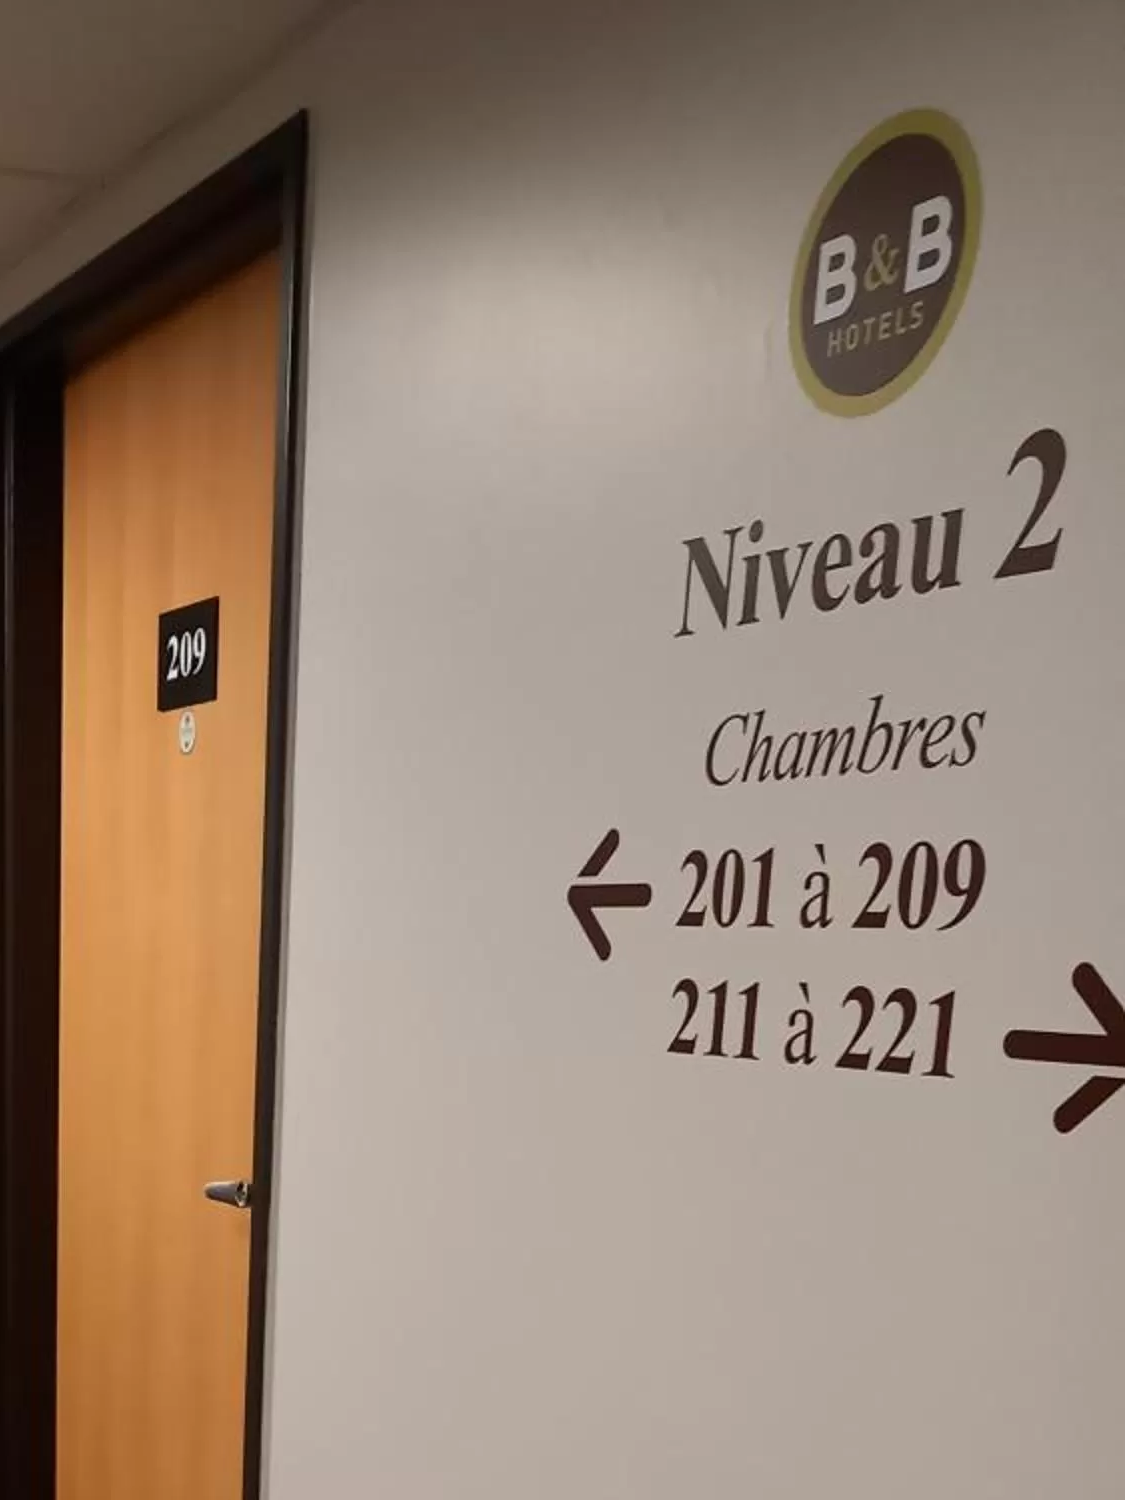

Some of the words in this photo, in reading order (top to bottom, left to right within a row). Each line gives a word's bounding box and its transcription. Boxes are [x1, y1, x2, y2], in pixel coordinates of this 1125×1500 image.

[813, 196, 953, 324] B&B
[827, 301, 925, 357] HOTELS
[675, 508, 964, 638] Niveau
[993, 427, 1067, 579] 2
[166, 627, 207, 681] 209
[705, 694, 987, 786] Chambres
[675, 847, 776, 929] 201
[800, 843, 833, 929] à
[851, 838, 987, 932] 209
[667, 978, 761, 1061] 211
[784, 982, 817, 1066] à
[835, 984, 956, 1079] 221
